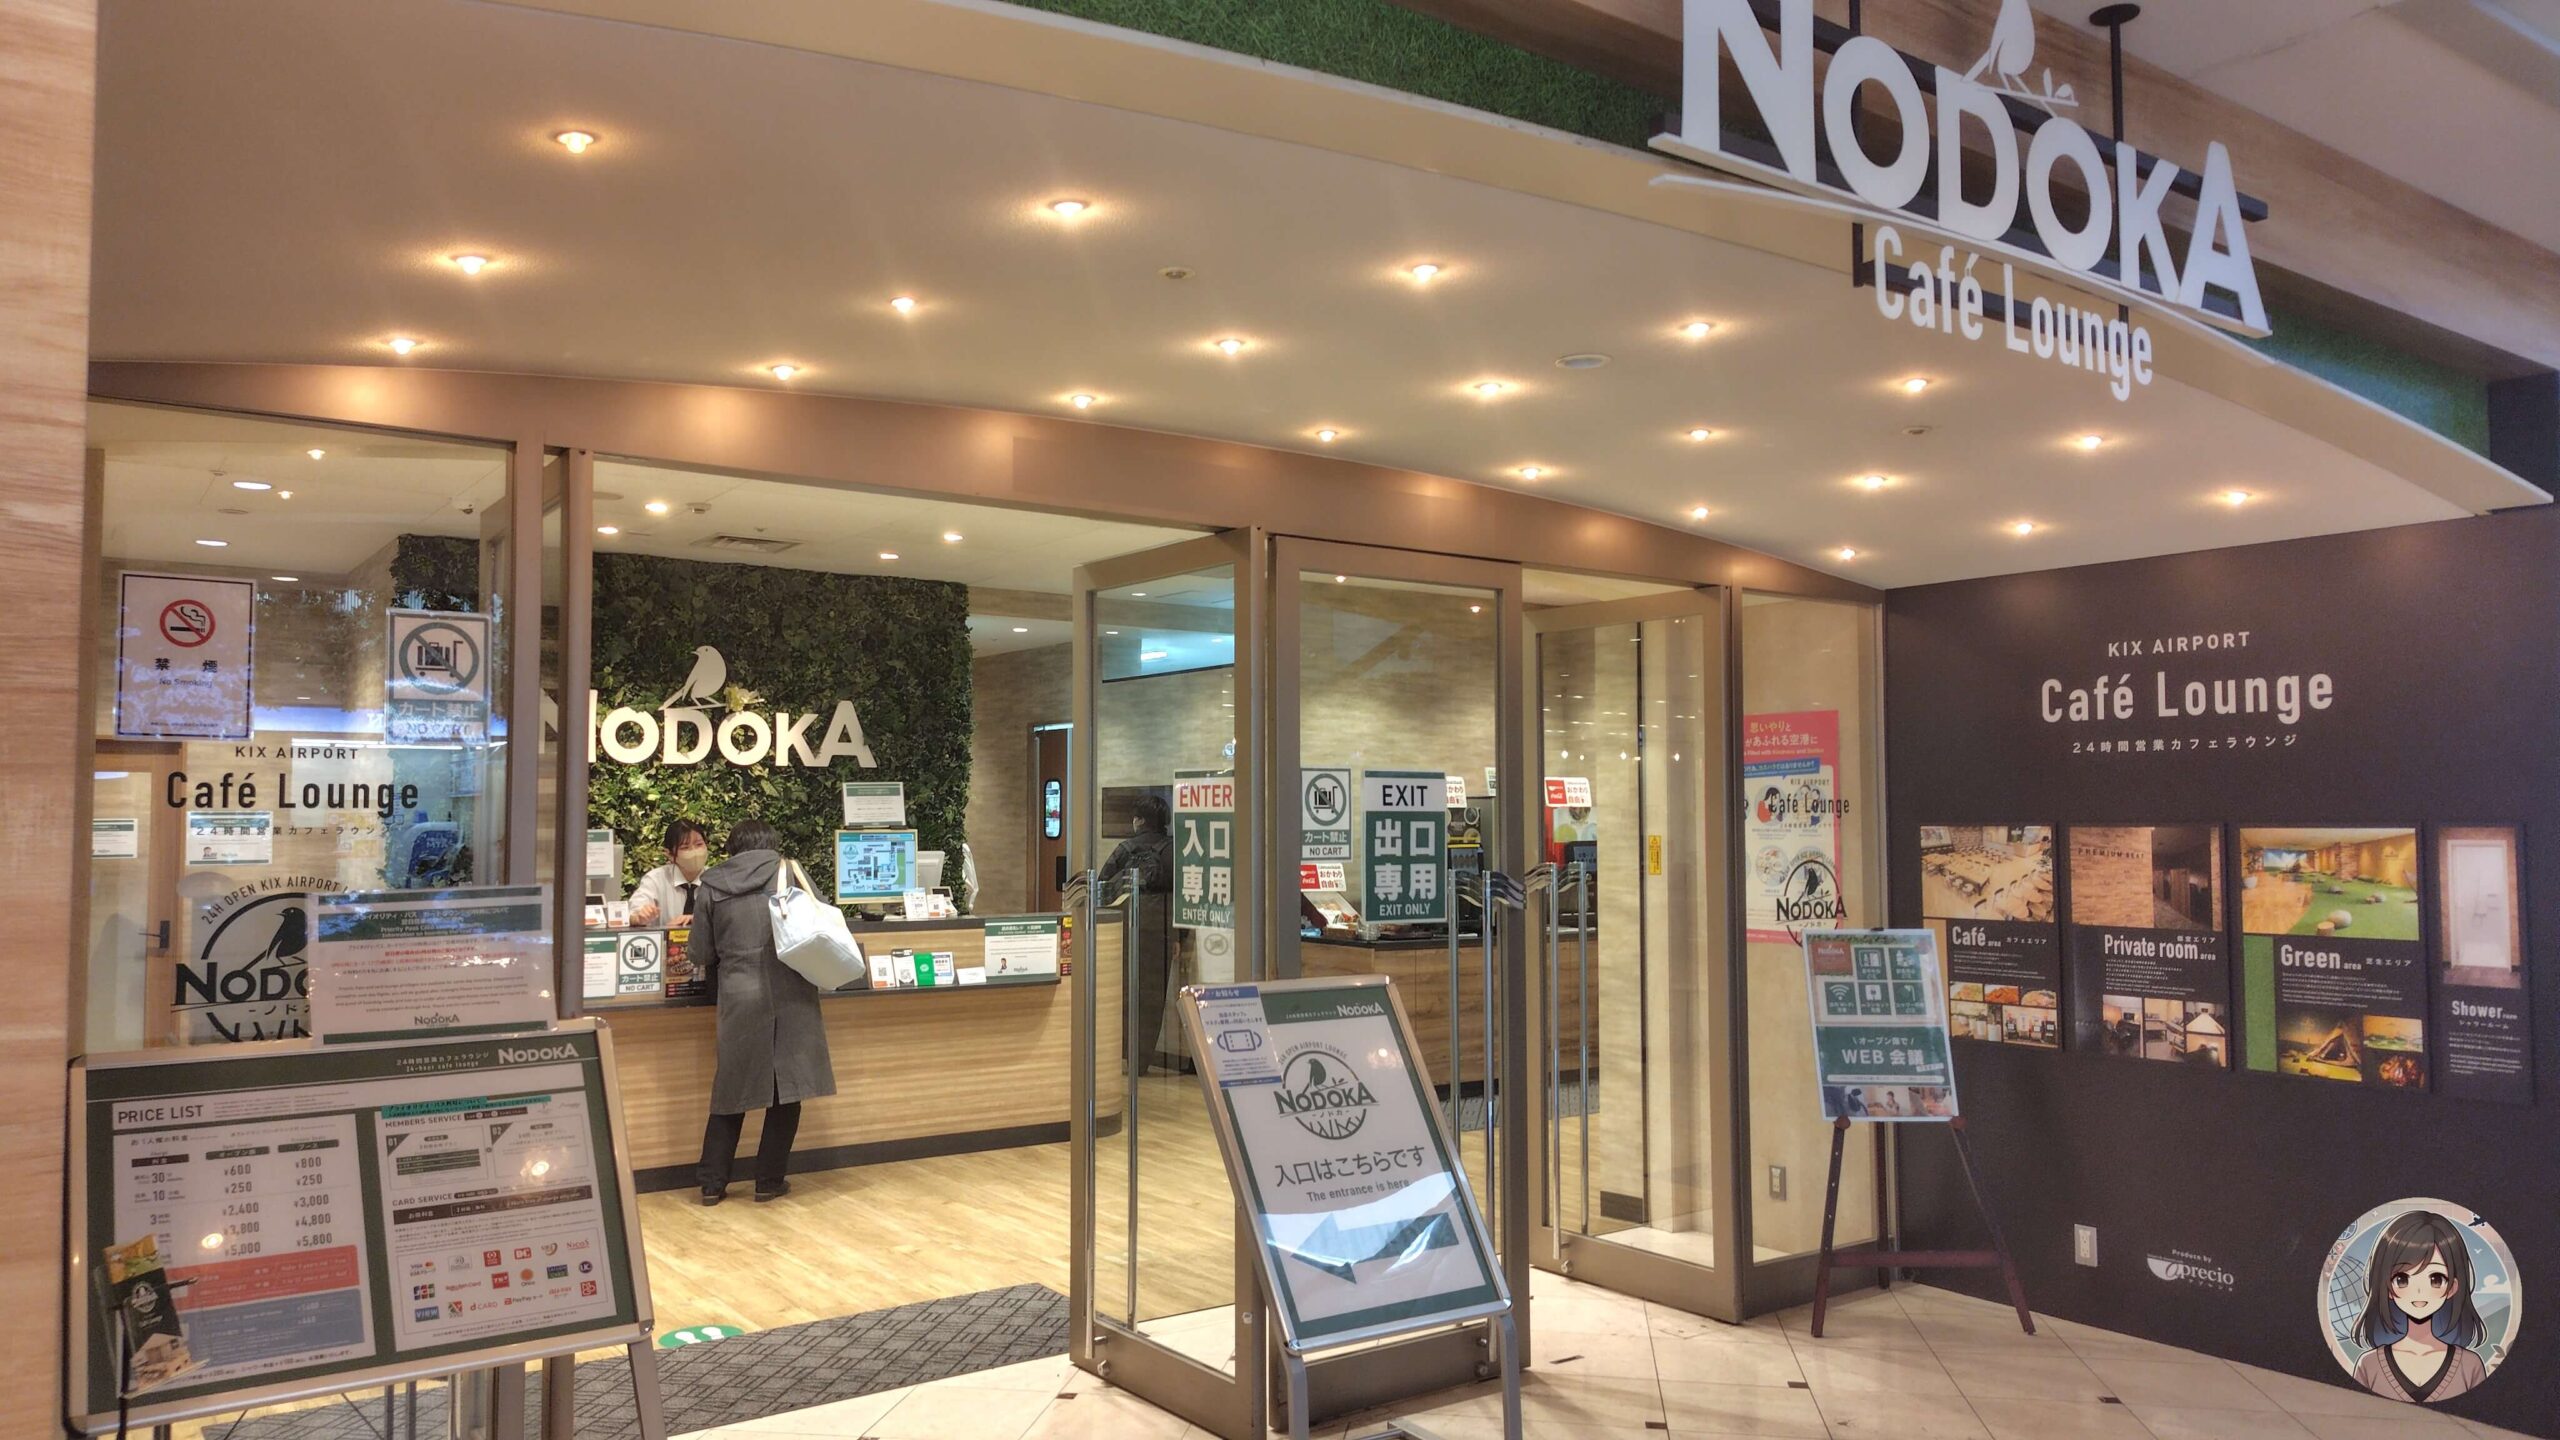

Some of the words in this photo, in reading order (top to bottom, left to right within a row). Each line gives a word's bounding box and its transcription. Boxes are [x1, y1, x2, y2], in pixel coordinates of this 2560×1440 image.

[1681, 0, 2272, 335] NODOKA
[1874, 225, 1984, 341] Café
[2003, 262, 2153, 401] Lounge
[2108, 640, 2143, 657] KIX
[2152, 631, 2250, 655] AIRPORT
[2041, 673, 2134, 723] Café
[2157, 671, 2334, 725] Lounge
[1750, 721, 1792, 733] 思いやりと
[235, 746, 267, 758] KIX
[276, 748, 359, 760] AIRPORT
[2072, 734, 2297, 754] 24時間営業カフェラウンジ
[167, 772, 257, 809] Café
[279, 773, 419, 819] Lounge
[1179, 784, 1233, 808] ENTER
[1382, 784, 1428, 807] EXIT
[1770, 793, 1799, 814] Café
[1805, 792, 1850, 819] Lounge
[1182, 819, 1231, 860] 入口
[1304, 831, 1347, 843] カート禁止
[1374, 818, 1436, 857] 出口
[1309, 847, 1321, 856] NO
[1322, 846, 1343, 856] CART
[1182, 864, 1231, 906] 専用
[1374, 862, 1436, 902] 専用
[201, 906, 225, 925] 24H
[226, 883, 257, 906] OPEN
[260, 876, 281, 892] KIX
[287, 876, 340, 892] AIRPORT
[1379, 904, 1403, 917] EXIT
[1405, 903, 1431, 916] ONLY
[1776, 895, 1848, 921] NODOKA
[1182, 908, 1208, 922] ENTER
[1209, 909, 1231, 924] ONLY
[1952, 926, 1986, 947] Café
[2104, 934, 2156, 958] Private
[2160, 942, 2198, 960] room
[2280, 944, 2341, 970] Green
[2343, 962, 2362, 971] area
[414, 1013, 460, 1026] NODOKA
[1336, 1001, 1384, 1017] NODOKA
[2451, 1000, 2503, 1019] Shower
[498, 1043, 580, 1065] NODOKA
[1841, 1049, 1885, 1065] WEB
[1889, 1049, 1924, 1066] 会議
[1273, 1081, 1377, 1114] NODOKA
[118, 1107, 165, 1124] PRICE
[170, 1105, 205, 1119] LIST
[385, 1117, 426, 1129] MEMBERS
[428, 1114, 462, 1125] SERVICE
[387, 1138, 398, 1148] 01
[151, 1172, 166, 1184] 30
[224, 1164, 252, 1177] ¥600
[294, 1157, 322, 1169] ¥800
[1273, 1146, 1426, 1188] 入口はこちらです
[152, 1190, 165, 1201] 10
[224, 1182, 253, 1195] ¥250
[296, 1174, 323, 1186] ¥250
[1306, 1191, 1326, 1203] The
[1329, 1184, 1374, 1200] entrance
[1376, 1181, 1385, 1192] is
[1387, 1177, 1410, 1191] here
[150, 1215, 158, 1225] 3
[222, 1202, 260, 1217] ¥2,400
[294, 1194, 330, 1209] ¥3,000
[392, 1195, 416, 1207] CARD
[417, 1193, 453, 1204] SERVICE
[295, 1213, 332, 1228] ¥4,800
[296, 1233, 333, 1247] ¥5,800
[2166, 1261, 2234, 1285] aprecio
